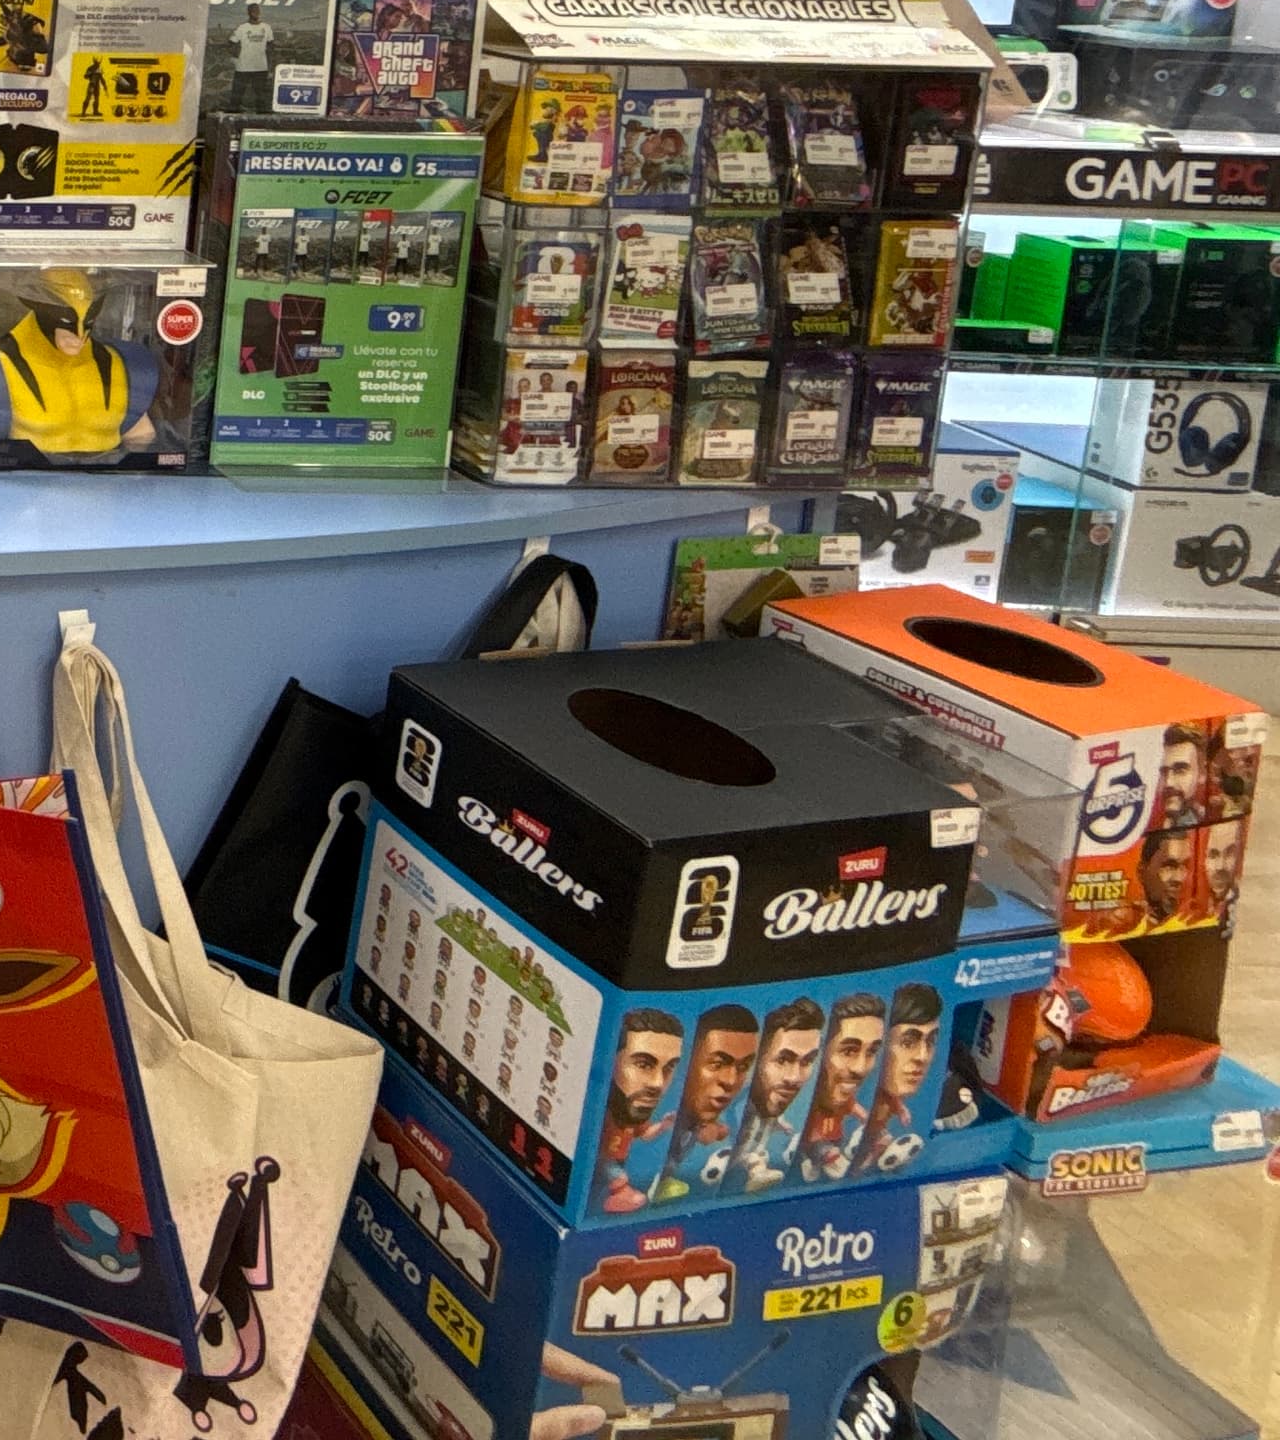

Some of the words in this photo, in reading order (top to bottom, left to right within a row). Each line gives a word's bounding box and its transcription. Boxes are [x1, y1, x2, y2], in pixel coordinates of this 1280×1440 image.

[547, 0, 653, 17] CARTAS
[656, 0, 894, 20] COLECCIONABLES
[249, 141, 261, 149] EA
[264, 141, 300, 149] SPORTS
[302, 142, 312, 150] FC
[316, 142, 326, 150] 27
[245, 155, 351, 172] ¡RESÉRVALO
[357, 159, 383, 172] YA!
[416, 163, 437, 176] 25
[1066, 158, 1215, 202] GAME
[1219, 165, 1269, 194] PC
[1217, 196, 1265, 204] GAMING
[109, 216, 131, 227] 50€
[144, 213, 174, 223] GAME
[376, 370, 400, 379] DLC
[412, 371, 427, 379] un
[242, 391, 265, 399] DLC
[360, 382, 424, 391] Steelbook
[887, 380, 931, 392] MAGIC
[1146, 380, 1181, 452] G535
[368, 431, 392, 441] 50€
[515, 812, 549, 841] ZURU
[386, 848, 407, 875] 42
[458, 796, 603, 913] Ballers
[845, 859, 879, 871] ZURU
[765, 882, 945, 939] Ballers
[1053, 1149, 1140, 1177] SONIC
[356, 1196, 422, 1285] Retro
[644, 1237, 675, 1250] ZURU
[777, 1225, 873, 1274] Retro
[586, 1274, 728, 1328] MAX
[800, 1289, 841, 1311] 221
[893, 1297, 912, 1324] 6
